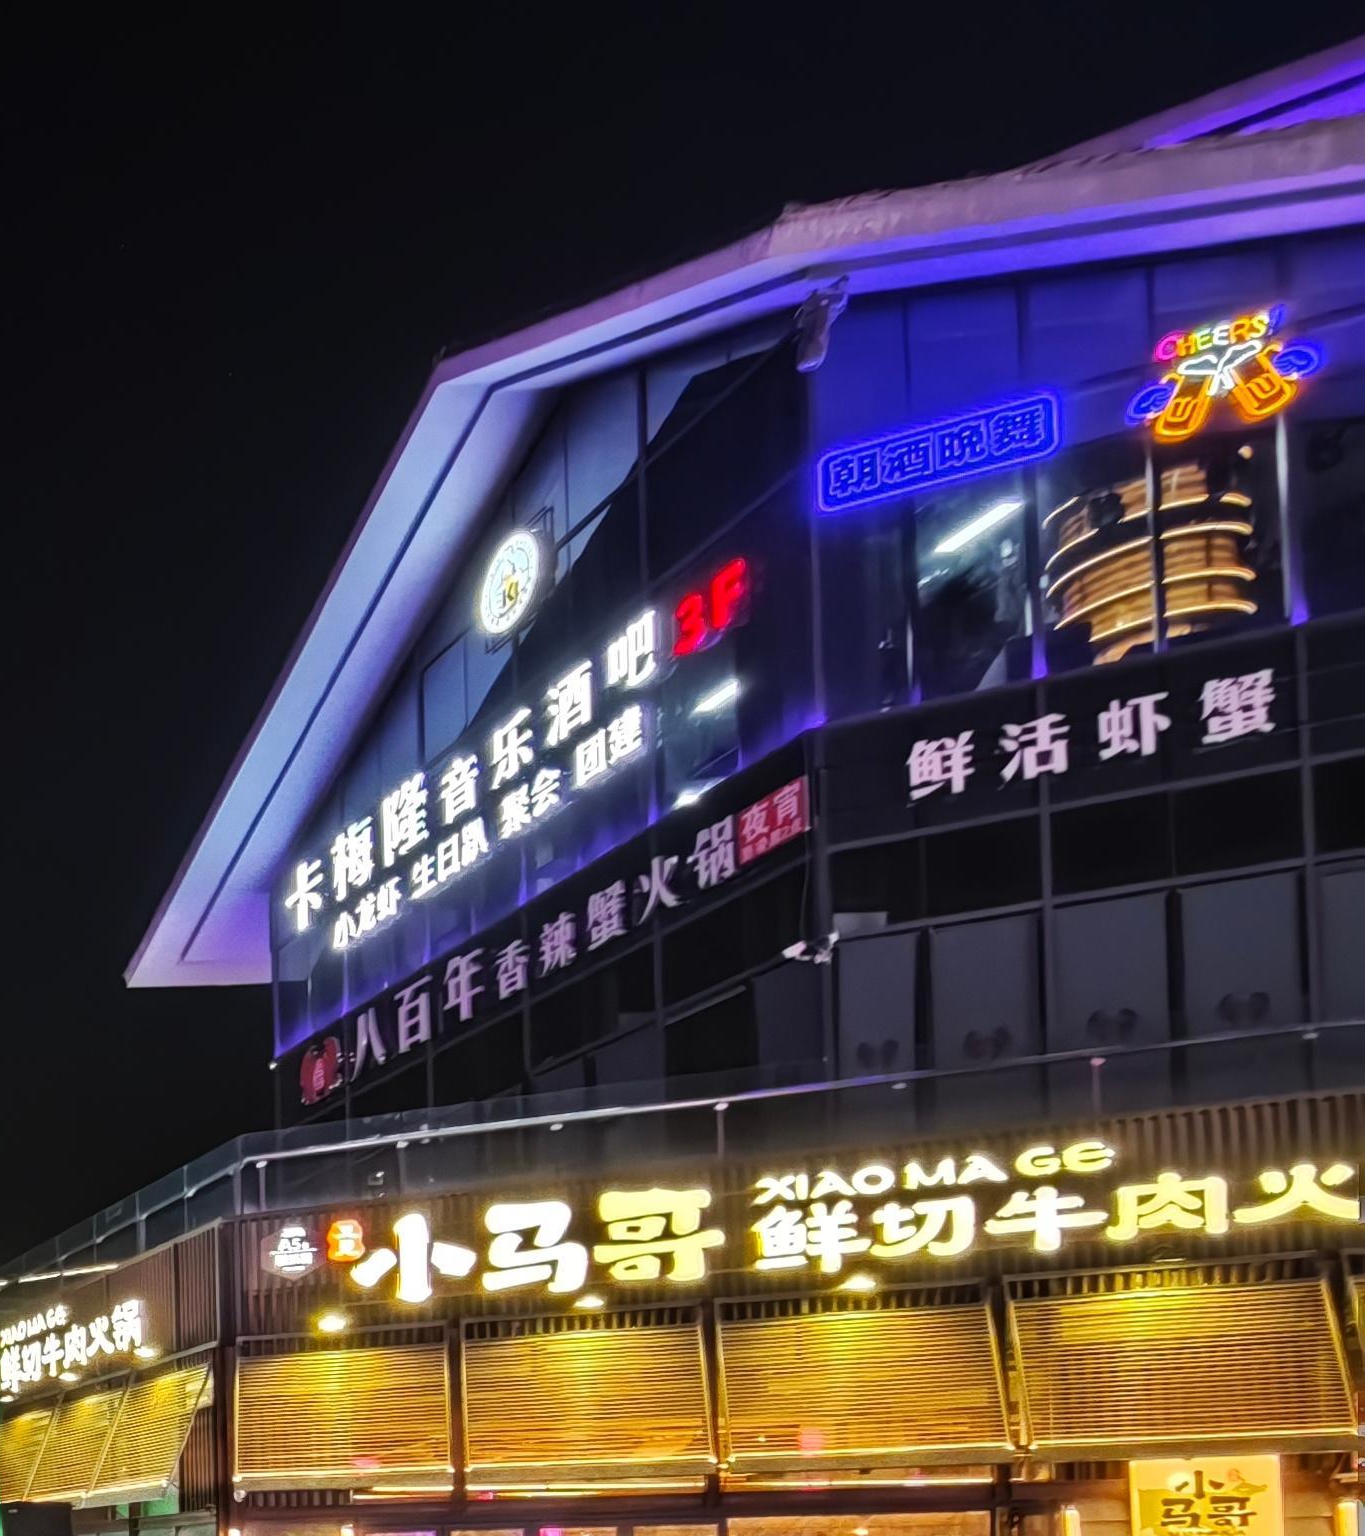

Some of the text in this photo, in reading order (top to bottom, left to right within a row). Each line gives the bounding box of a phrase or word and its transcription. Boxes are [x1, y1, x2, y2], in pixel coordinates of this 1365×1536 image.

[1153, 303, 1287, 361] CHEERS!
[829, 404, 1046, 497] 朝酒晚舞
[285, 609, 657, 932] 卡梅隆音乐酒吧
[673, 557, 748, 656] 3F
[905, 668, 1276, 801] 鲜活虾蟹
[333, 876, 402, 949] 小龙虾
[498, 768, 562, 838] 聚会
[575, 705, 644, 786] 团建
[740, 781, 801, 845] 夜宵
[350, 814, 736, 1082] 八百年香辣蟹火锅
[753, 1142, 1116, 1204] XIAO MA GE
[351, 1163, 1360, 1303] 小马哥 鲜切牛肉火
[0, 1300, 142, 1393] 鲜切牛肉火锅
[1160, 1496, 1257, 1528] 马哥
[1175, 1470, 1225, 1499] 小
